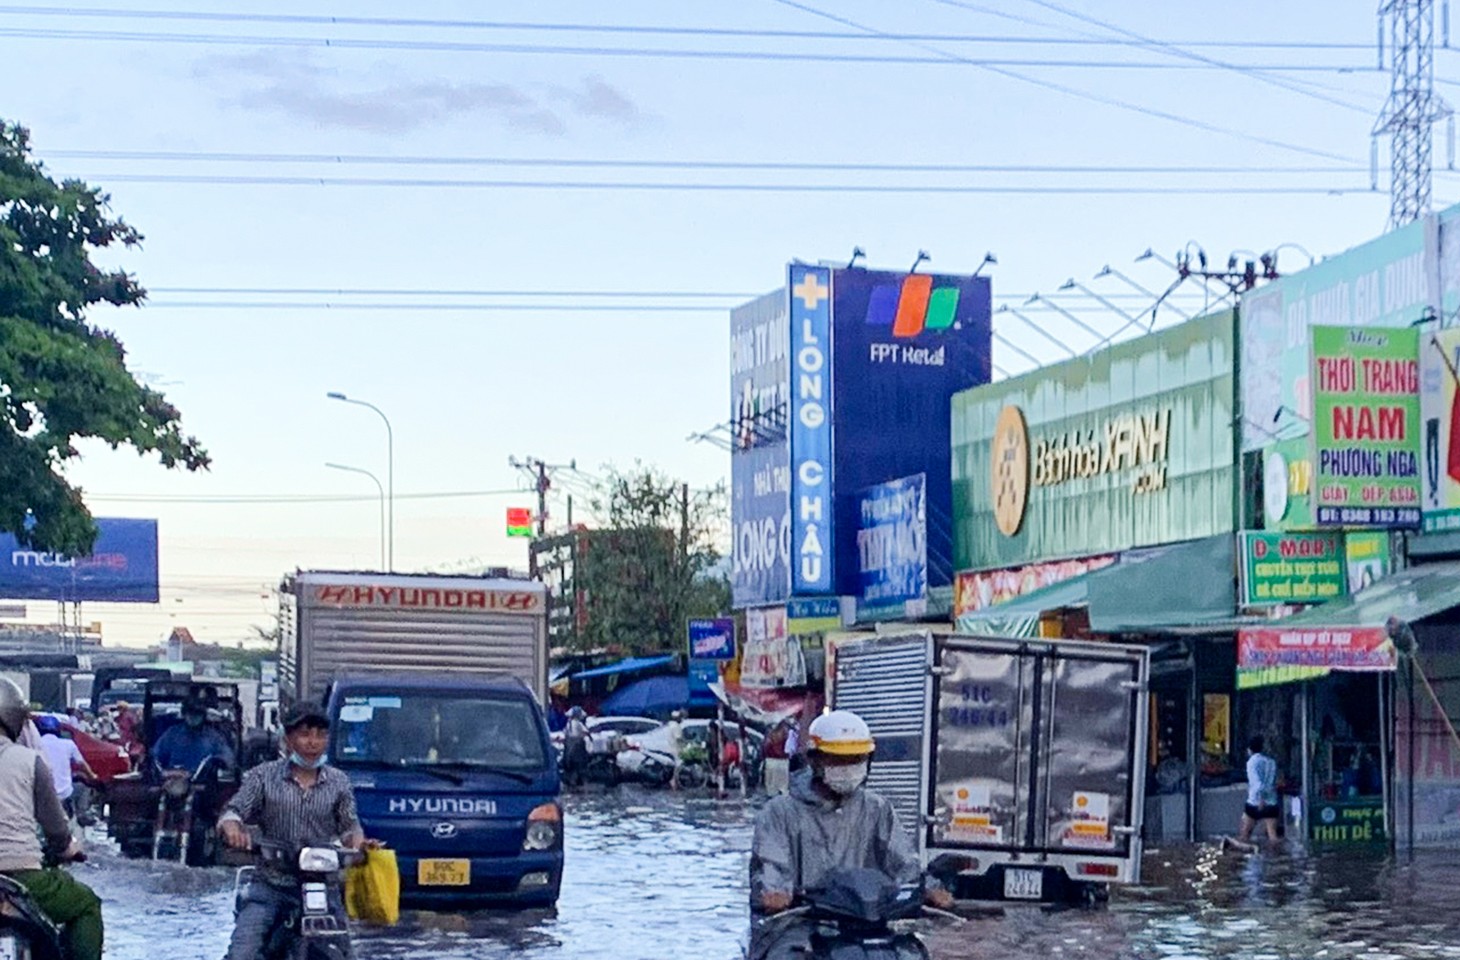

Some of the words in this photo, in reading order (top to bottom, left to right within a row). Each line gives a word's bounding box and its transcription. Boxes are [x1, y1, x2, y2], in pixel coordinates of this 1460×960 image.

[870, 343, 898, 364] FPT
[798, 317, 826, 428] LONG
[1362, 359, 1420, 394] TRANG
[1332, 406, 1406, 440] NAM
[1102, 408, 1172, 475] XANH
[1320, 445, 1383, 477] PHƯƠNG
[1387, 451, 1418, 477] NGA
[797, 459, 825, 584] CHÂU
[734, 515, 776, 574] LONG
[351, 585, 496, 609] HYUNDAI
[388, 798, 497, 815] HYUNDAI
